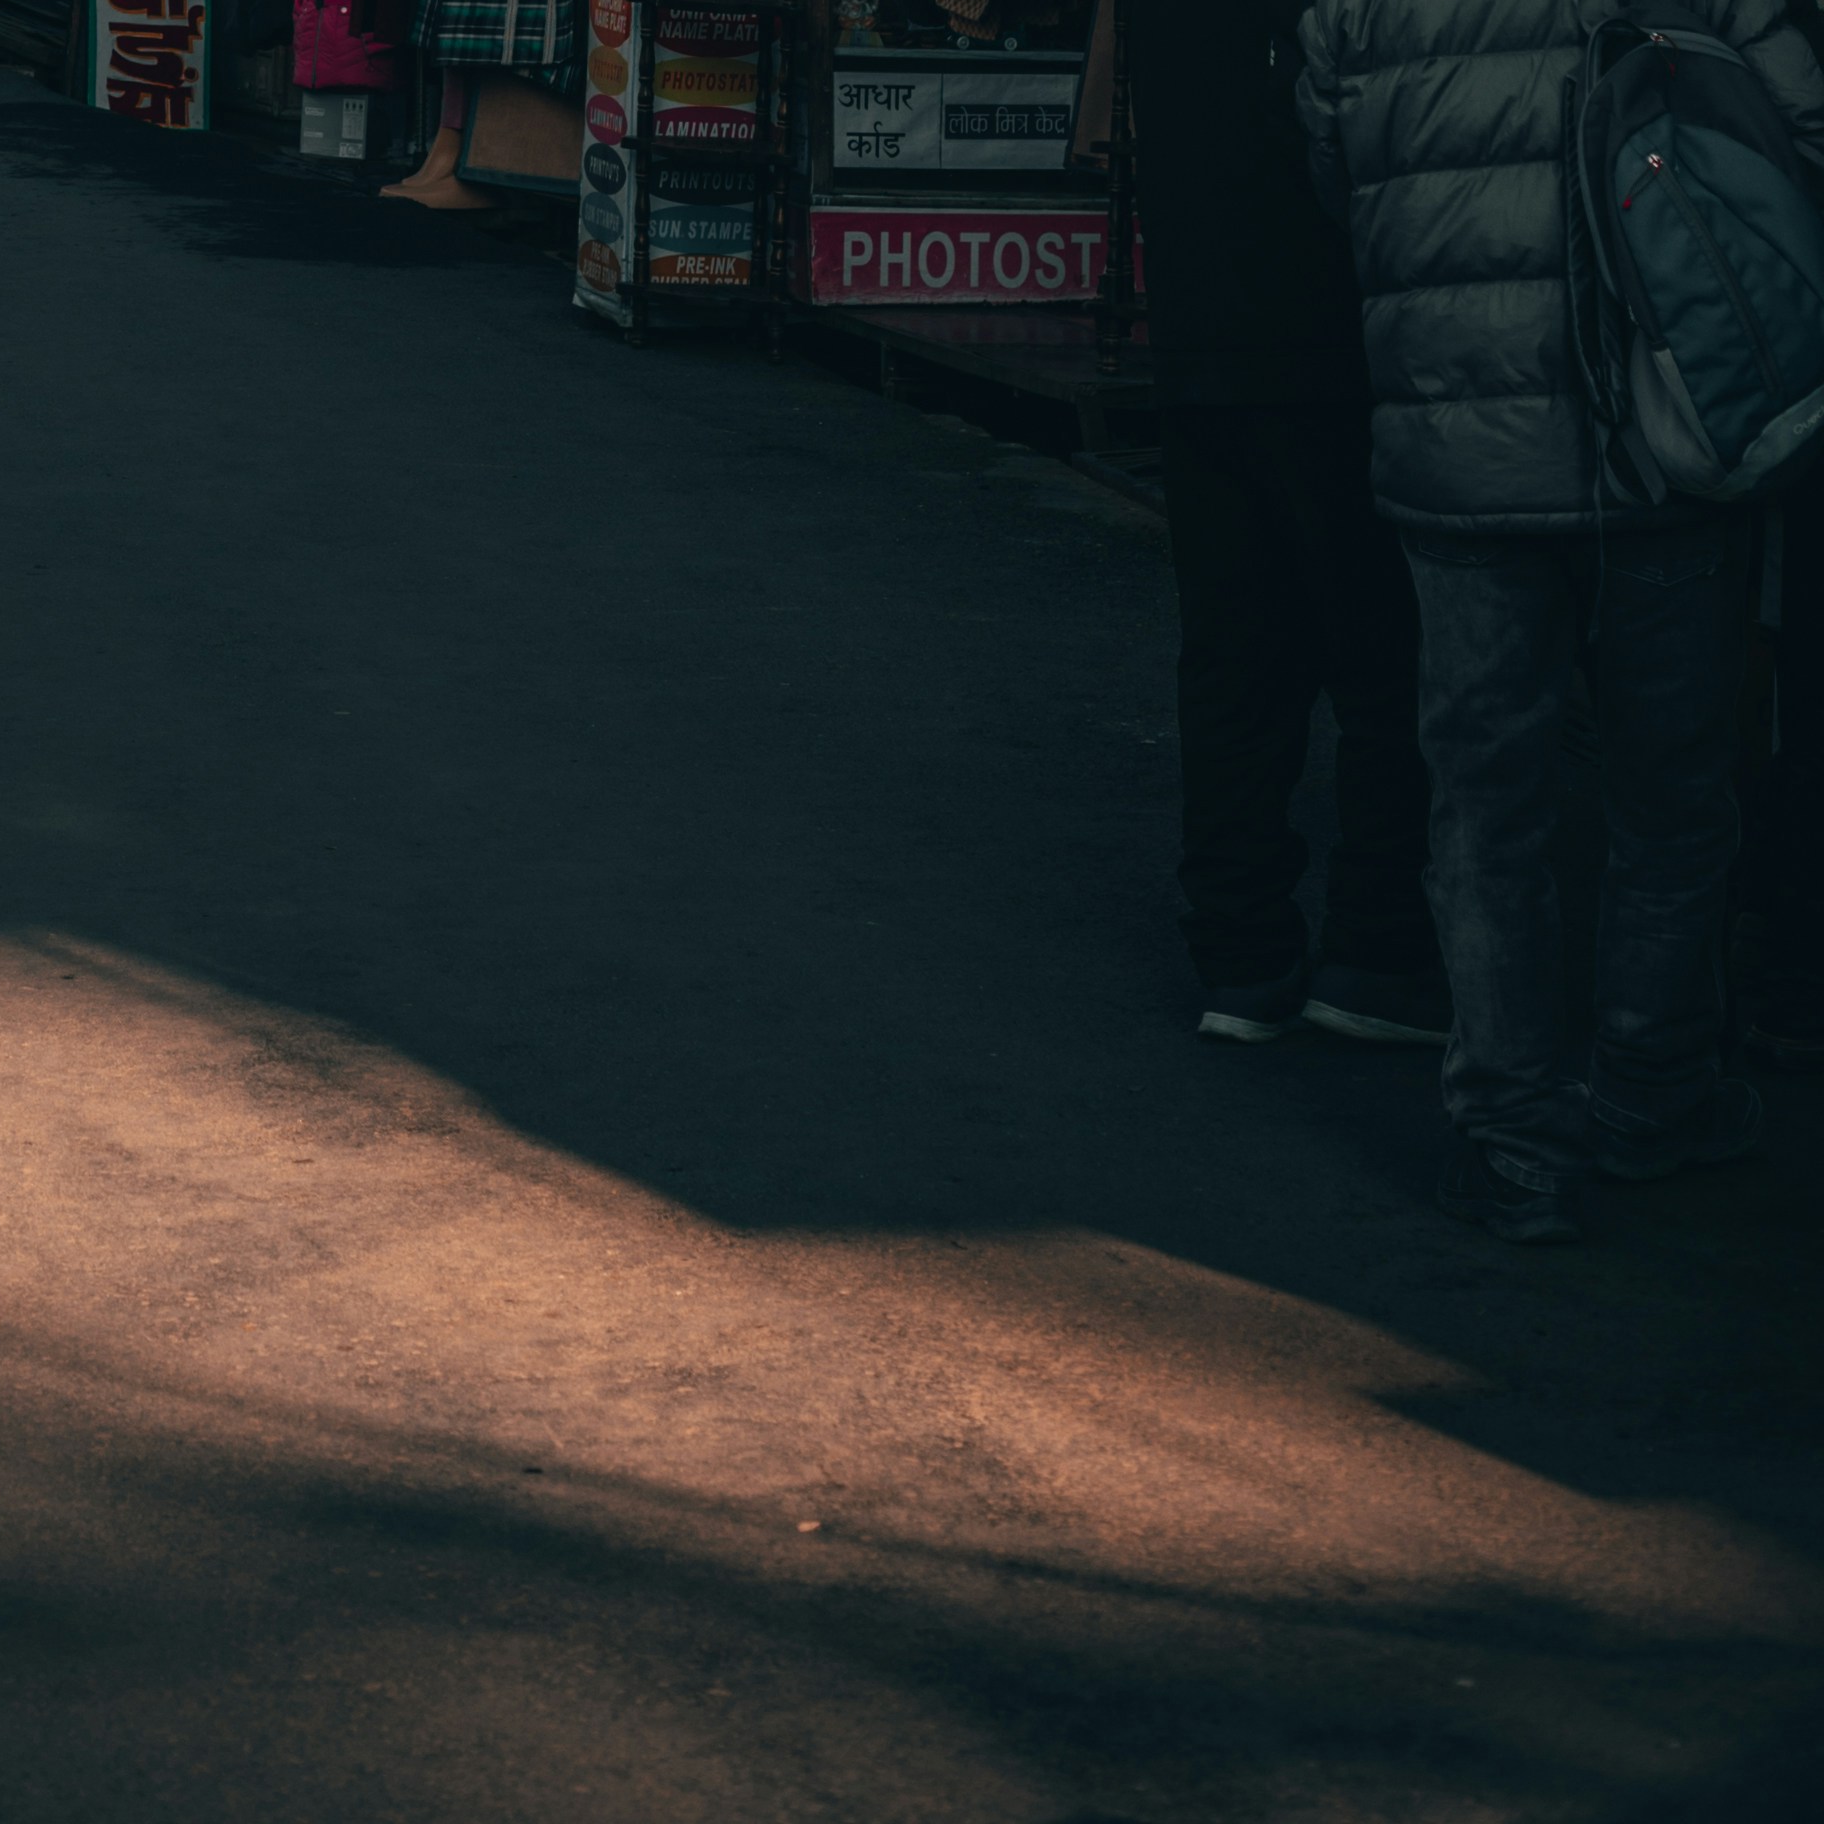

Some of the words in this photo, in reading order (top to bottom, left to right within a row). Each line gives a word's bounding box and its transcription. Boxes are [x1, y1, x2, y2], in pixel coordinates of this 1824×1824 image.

[659, 20, 707, 40] NAME
[838, 82, 916, 112] आधार
[589, 107, 624, 135] LAMINATION
[949, 104, 989, 137] लोक
[994, 106, 1029, 135] मित्र
[588, 155, 621, 183] PRINTOUTS
[658, 169, 756, 192] PRINTOUTS
[649, 219, 679, 239] SUN
[676, 255, 736, 277] PRE-INK
